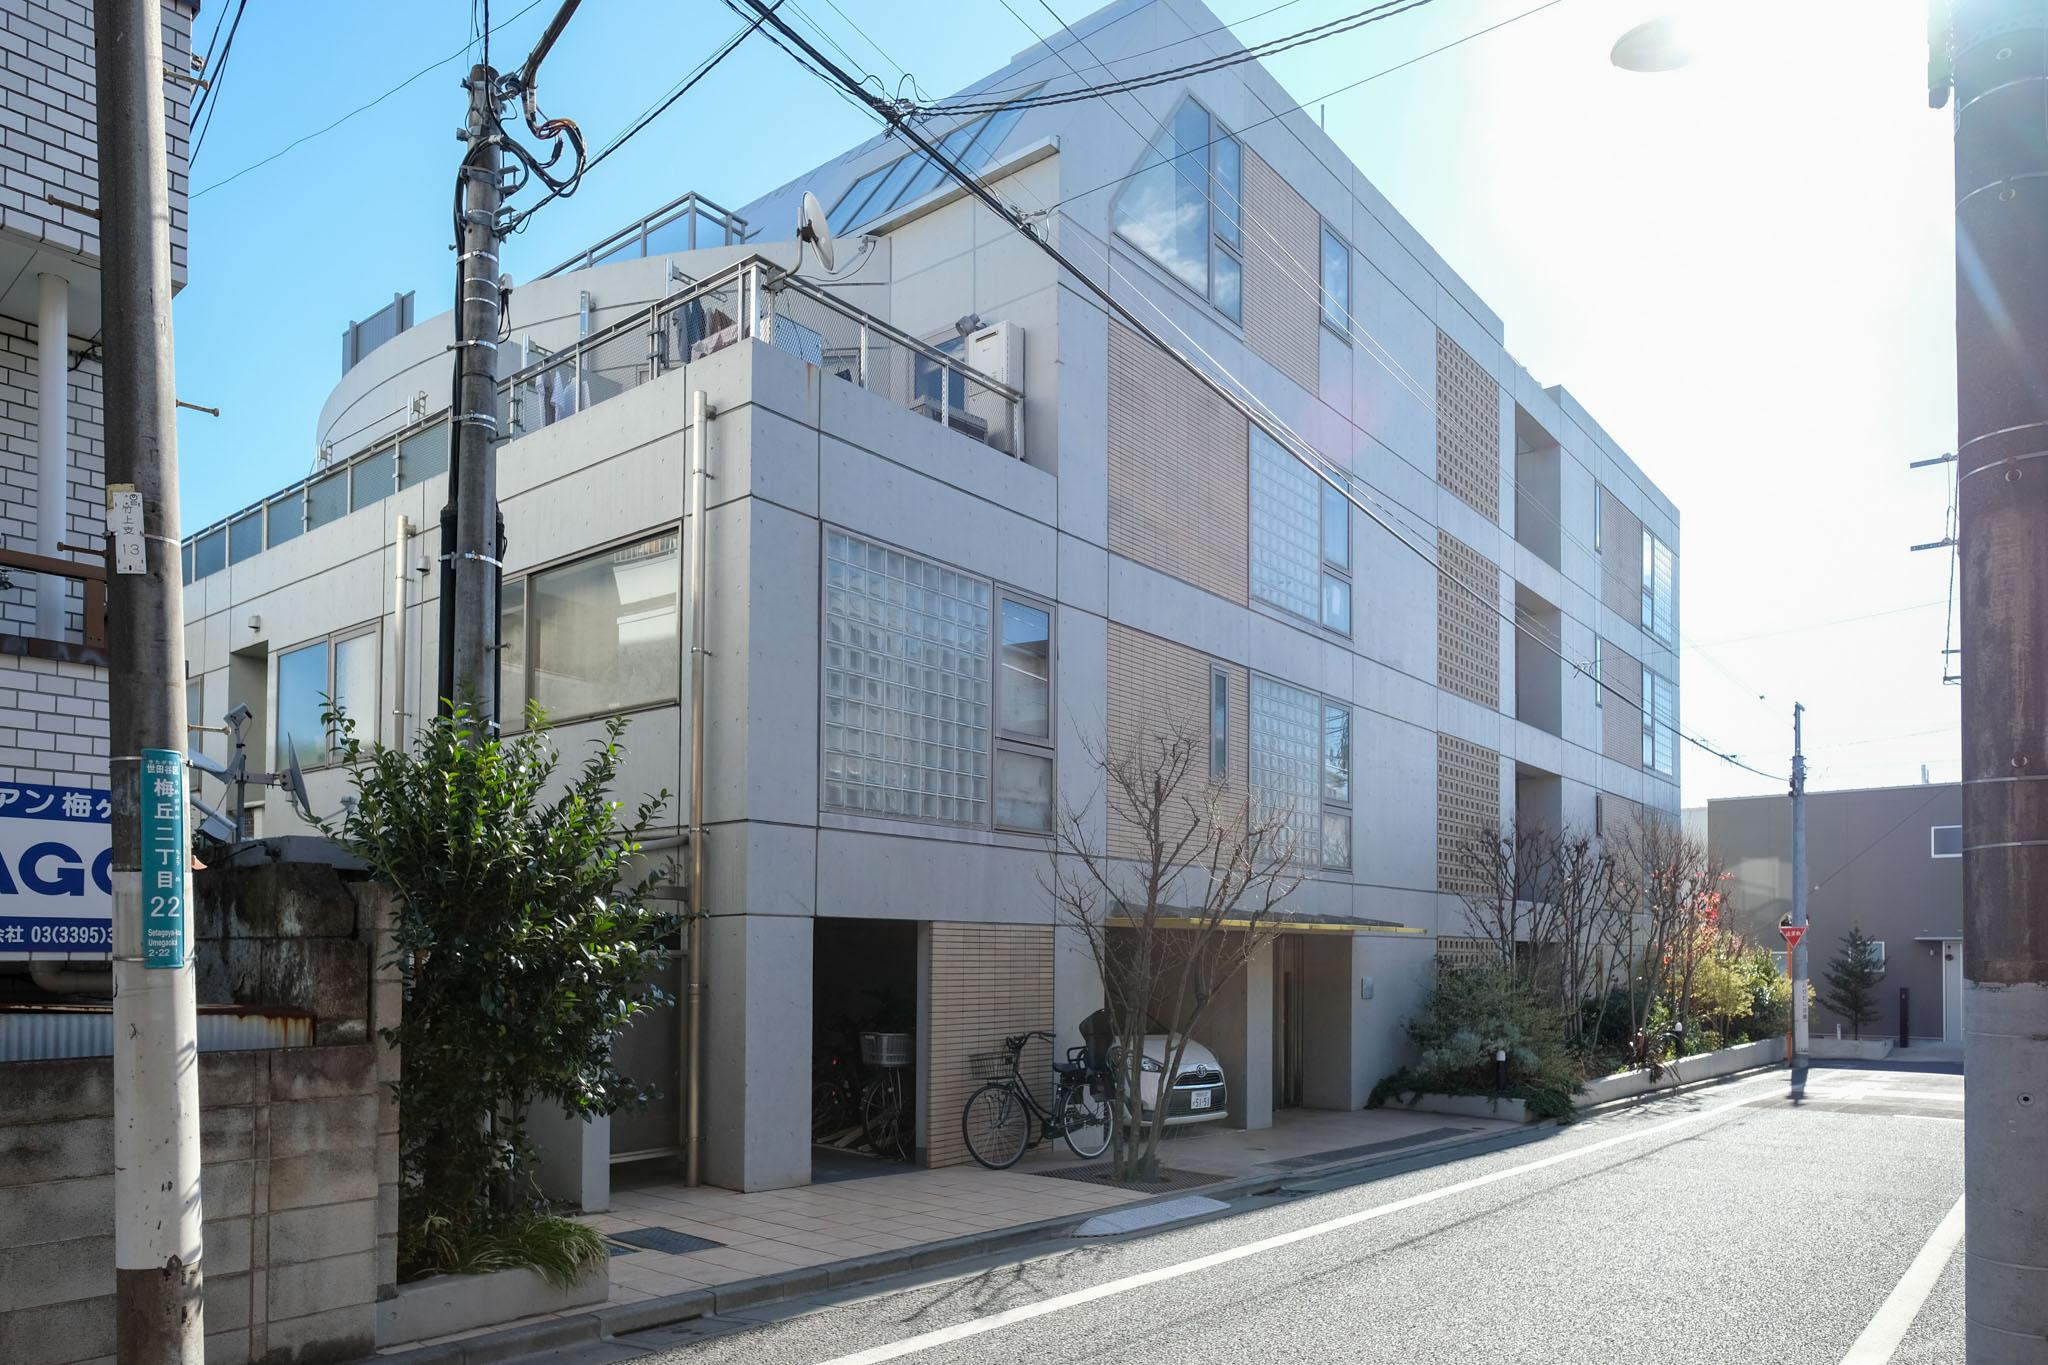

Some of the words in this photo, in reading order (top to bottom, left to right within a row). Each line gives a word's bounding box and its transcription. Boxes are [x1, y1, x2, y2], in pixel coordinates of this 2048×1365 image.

[123, 543, 140, 555] 13
[147, 763, 179, 775] 世田谷区
[154, 778, 174, 888] 梅丘二丁目
[150, 896, 180, 917] 22
[0, 925, 24, 943] 社
[148, 939, 177, 947] Umegaoka
